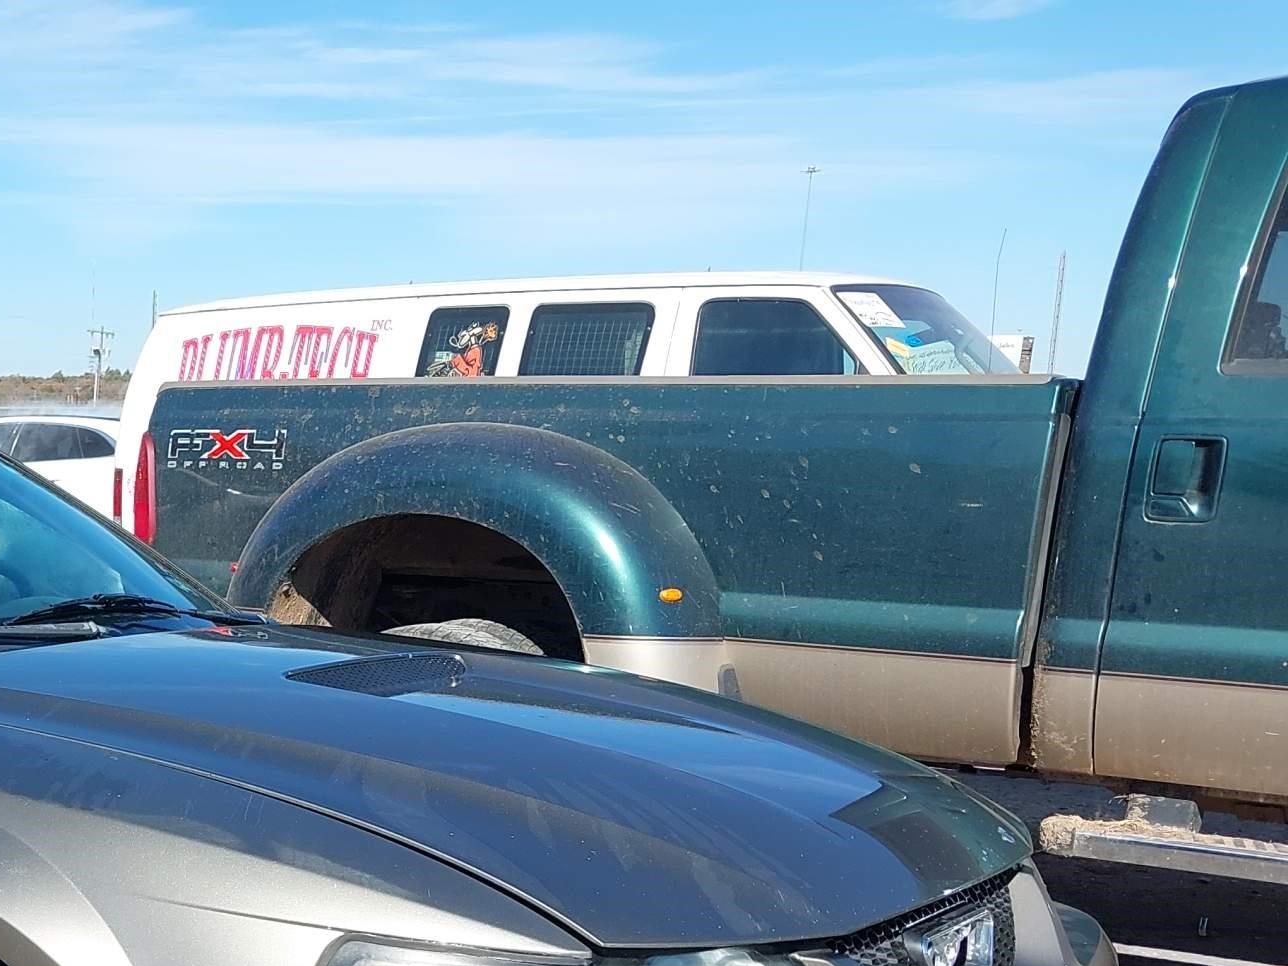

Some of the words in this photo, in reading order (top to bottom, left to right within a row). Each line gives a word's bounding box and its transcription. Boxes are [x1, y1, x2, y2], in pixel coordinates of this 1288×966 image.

[370, 319, 393, 331] INC.
[167, 429, 287, 460] FX4
[167, 460, 207, 469] OFF
[218, 460, 283, 469] ROAD
